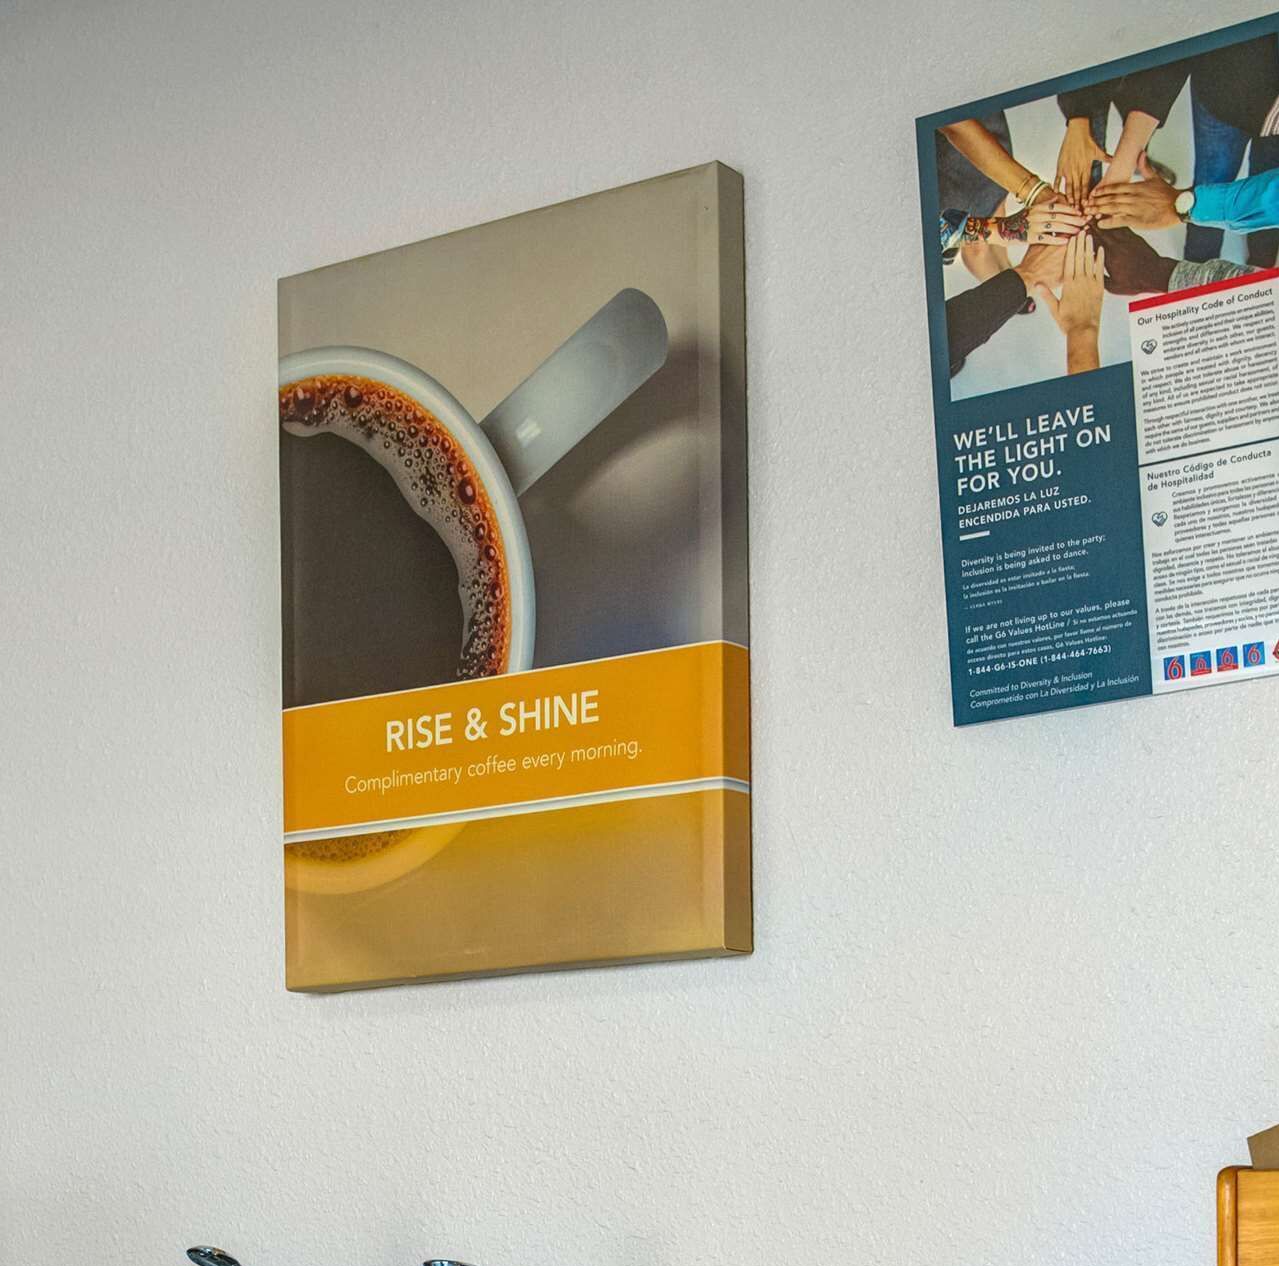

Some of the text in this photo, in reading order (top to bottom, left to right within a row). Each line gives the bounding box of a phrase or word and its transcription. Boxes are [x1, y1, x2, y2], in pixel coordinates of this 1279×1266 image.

[1137, 288, 1272, 326] Our Hospitality Code of Conduct
[1026, 404, 1094, 435] LEAVE
[954, 424, 1110, 473] THE LIGHT ON
[1147, 469, 1180, 480] Nuestro
[1216, 458, 1227, 466] de
[1230, 450, 1271, 463] Conducta
[957, 459, 1061, 496] FOR YOU.
[1147, 470, 1214, 491] de Hospitalidad
[958, 486, 1059, 515] DEJAREMOS LA LUZ
[959, 495, 1091, 528] ENCENDIDA PARA USTED.
[961, 556, 994, 567] Diversity
[1004, 550, 1026, 559] being
[1028, 543, 1054, 554] invited
[1067, 539, 1080, 547] the
[387, 690, 599, 752] RISE & SHINE
[345, 738, 643, 796] Complimentary coffee every morning.
